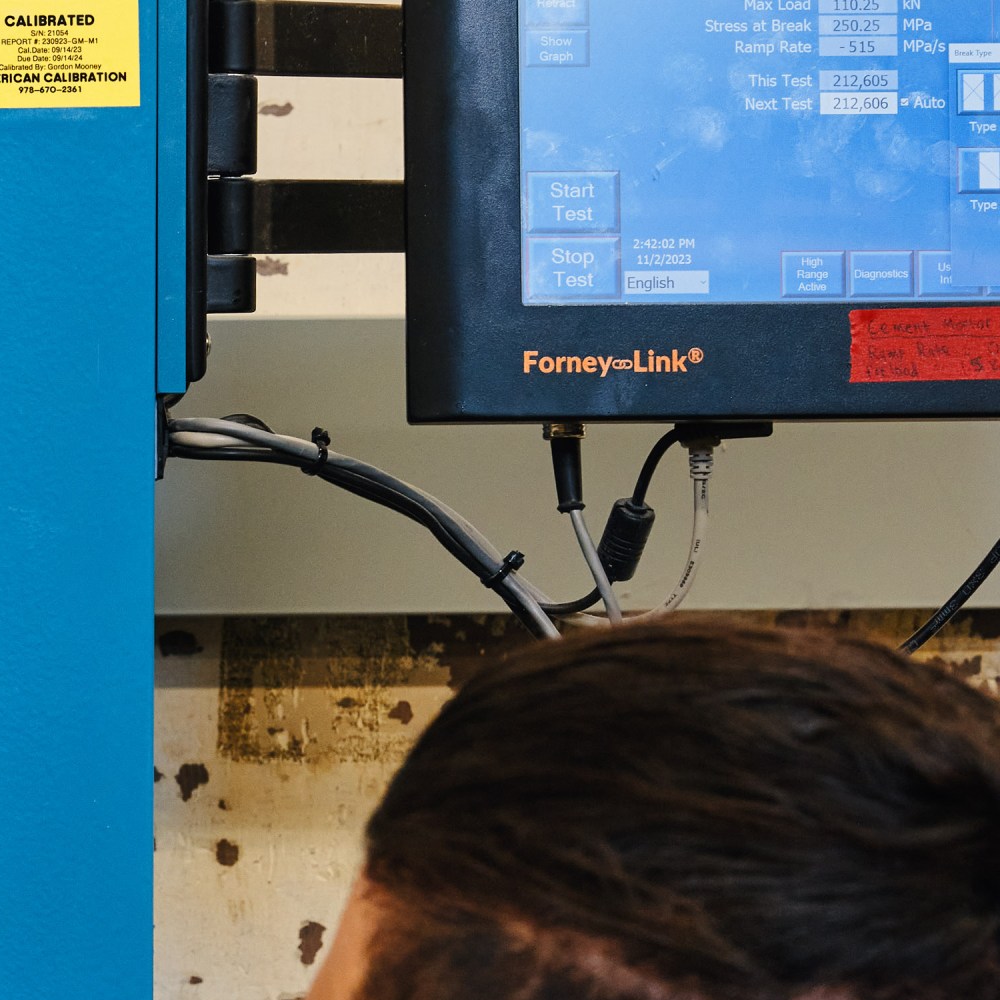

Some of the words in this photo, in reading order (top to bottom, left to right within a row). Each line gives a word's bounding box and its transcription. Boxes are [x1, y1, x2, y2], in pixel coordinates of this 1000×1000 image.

[744, 0, 773, 10] Max
[778, 0, 811, 10] Load
[834, 0, 880, 11] 110.25
[903, 0, 921, 10] kN
[4, 14, 95, 27] CALIBRATED
[705, 20, 748, 33] Stress
[753, 20, 767, 32] at
[772, 20, 812, 32] Break
[832, 20, 880, 32] 250.25
[903, 18, 932, 31] MPa
[540, 36, 573, 46] Show
[52, 46, 82, 54] 09/14/23
[735, 40, 774, 56] Ramp
[780, 40, 812, 53] Rate
[903, 39, 946, 55] MPa/s
[52, 54, 83, 62] 09/14/24
[540, 50, 574, 64] Graph
[976, 50, 992, 58] Type
[34, 64, 46, 72] By:
[74, 63, 102, 72] Mooney
[44, 72, 127, 83] CALIBRATION
[749, 74, 777, 87] This
[782, 74, 812, 88] Test
[832, 74, 889, 90] 212,605
[18, 86, 82, 94] 978-670-2361
[745, 98, 778, 111] Next
[782, 98, 813, 110] Test
[833, 97, 889, 112] 212,606
[914, 96, 946, 109] Auto
[969, 121, 997, 134] Type
[550, 182, 595, 199] Start
[970, 200, 998, 212] Type
[552, 205, 593, 222] Test
[632, 238, 675, 249] 2:42:02
[679, 238, 695, 248] PM
[551, 248, 595, 269] Stop
[636, 254, 692, 266] 11/2/2023
[801, 257, 824, 269] High
[553, 271, 594, 287] Test
[796, 269, 829, 281] Range
[854, 269, 909, 280] Diagnostics
[626, 276, 675, 292] English
[798, 282, 827, 292] Active
[523, 350, 613, 378] Forney
